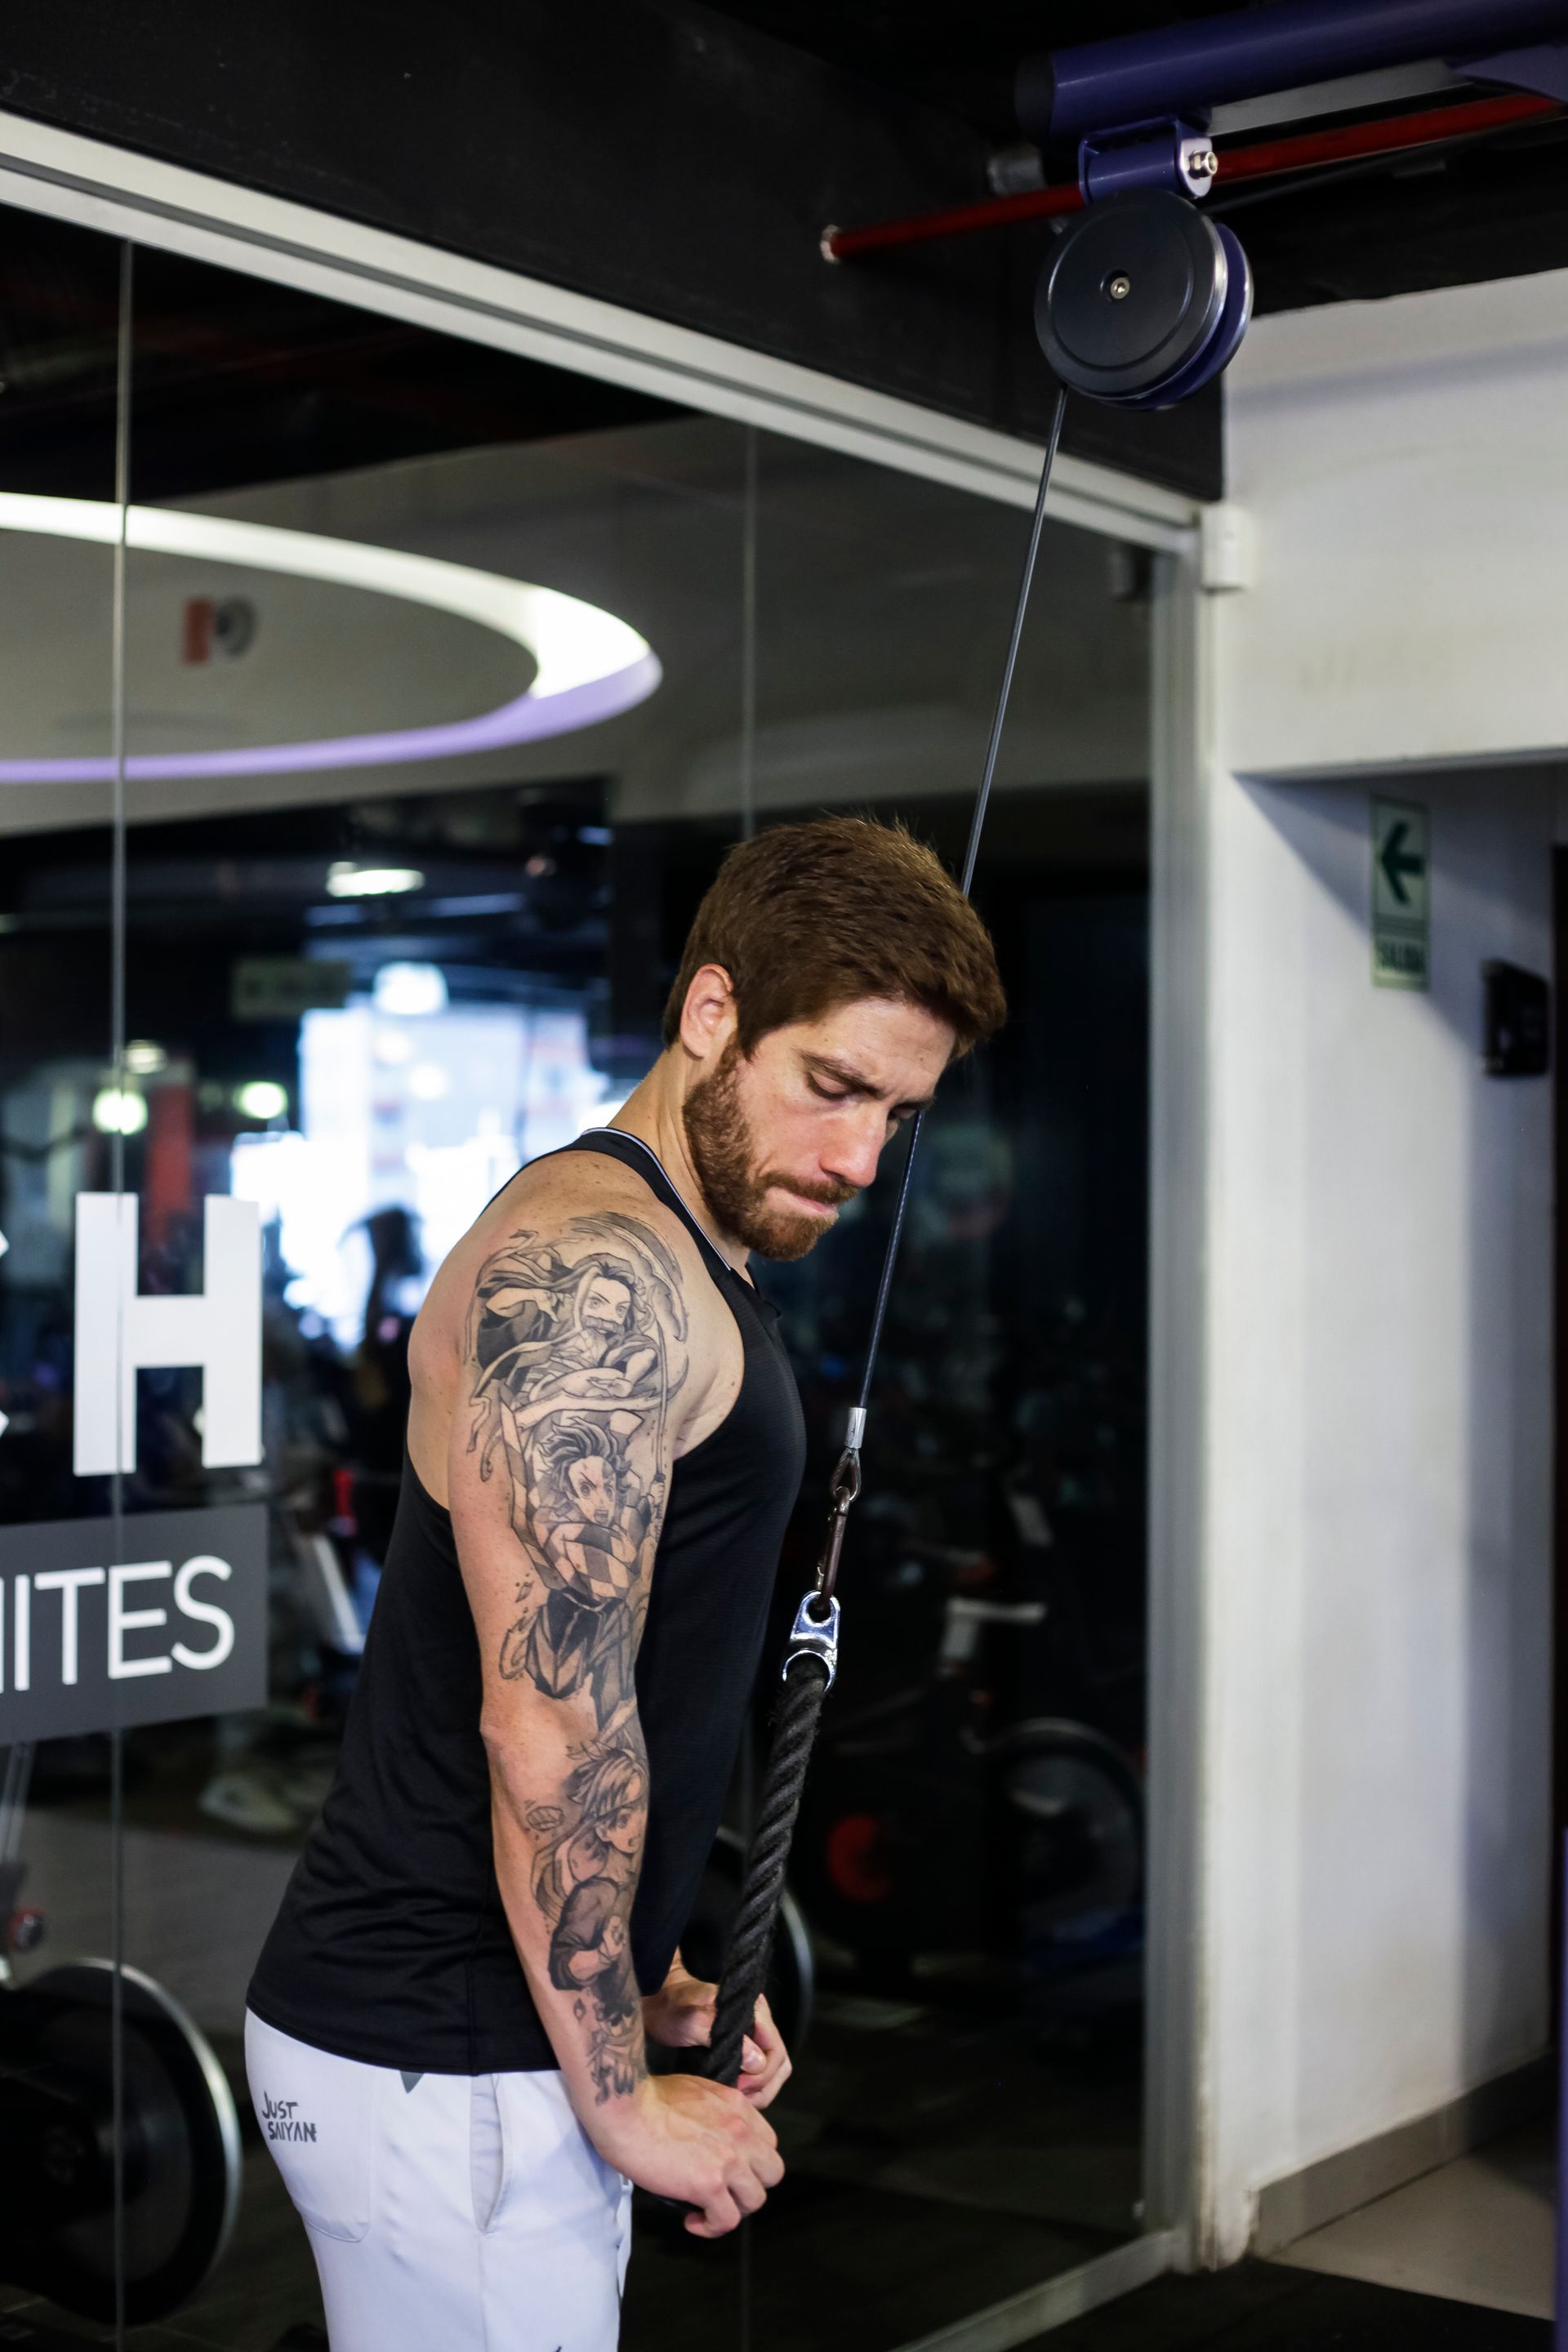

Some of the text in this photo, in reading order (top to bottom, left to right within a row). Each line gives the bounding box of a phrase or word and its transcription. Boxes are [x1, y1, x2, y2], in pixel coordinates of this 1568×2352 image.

[0, 1192, 263, 1477] H
[0, 1555, 235, 1694] ITES
[261, 2090, 300, 2119] JUST
[268, 2121, 318, 2142] SAIYAN
